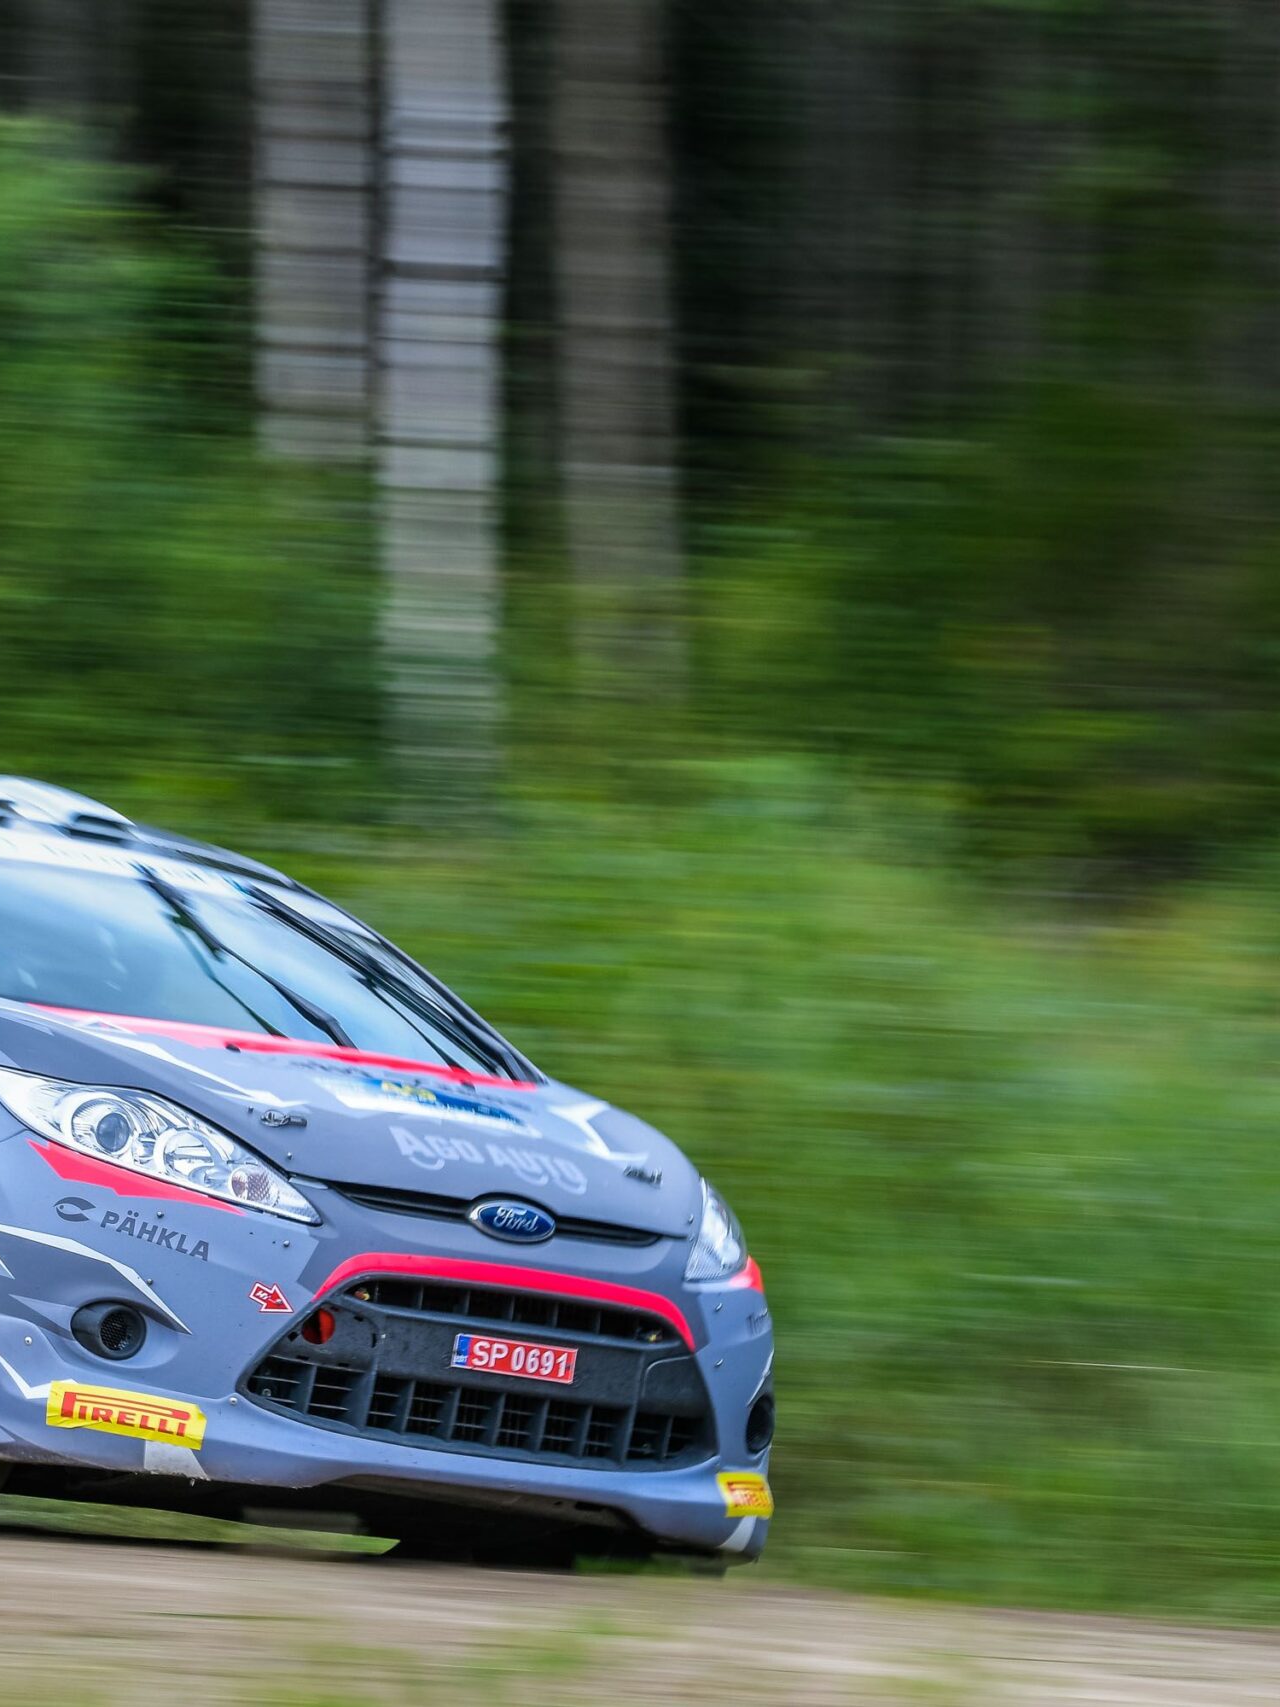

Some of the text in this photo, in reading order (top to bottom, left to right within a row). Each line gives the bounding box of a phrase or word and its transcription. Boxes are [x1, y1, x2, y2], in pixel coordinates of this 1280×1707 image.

[100, 1210, 210, 1261] PÄHKLA
[494, 1205, 539, 1232] Ford
[471, 1340, 568, 1378] SP 0691
[61, 1391, 191, 1437] PIRELLI
